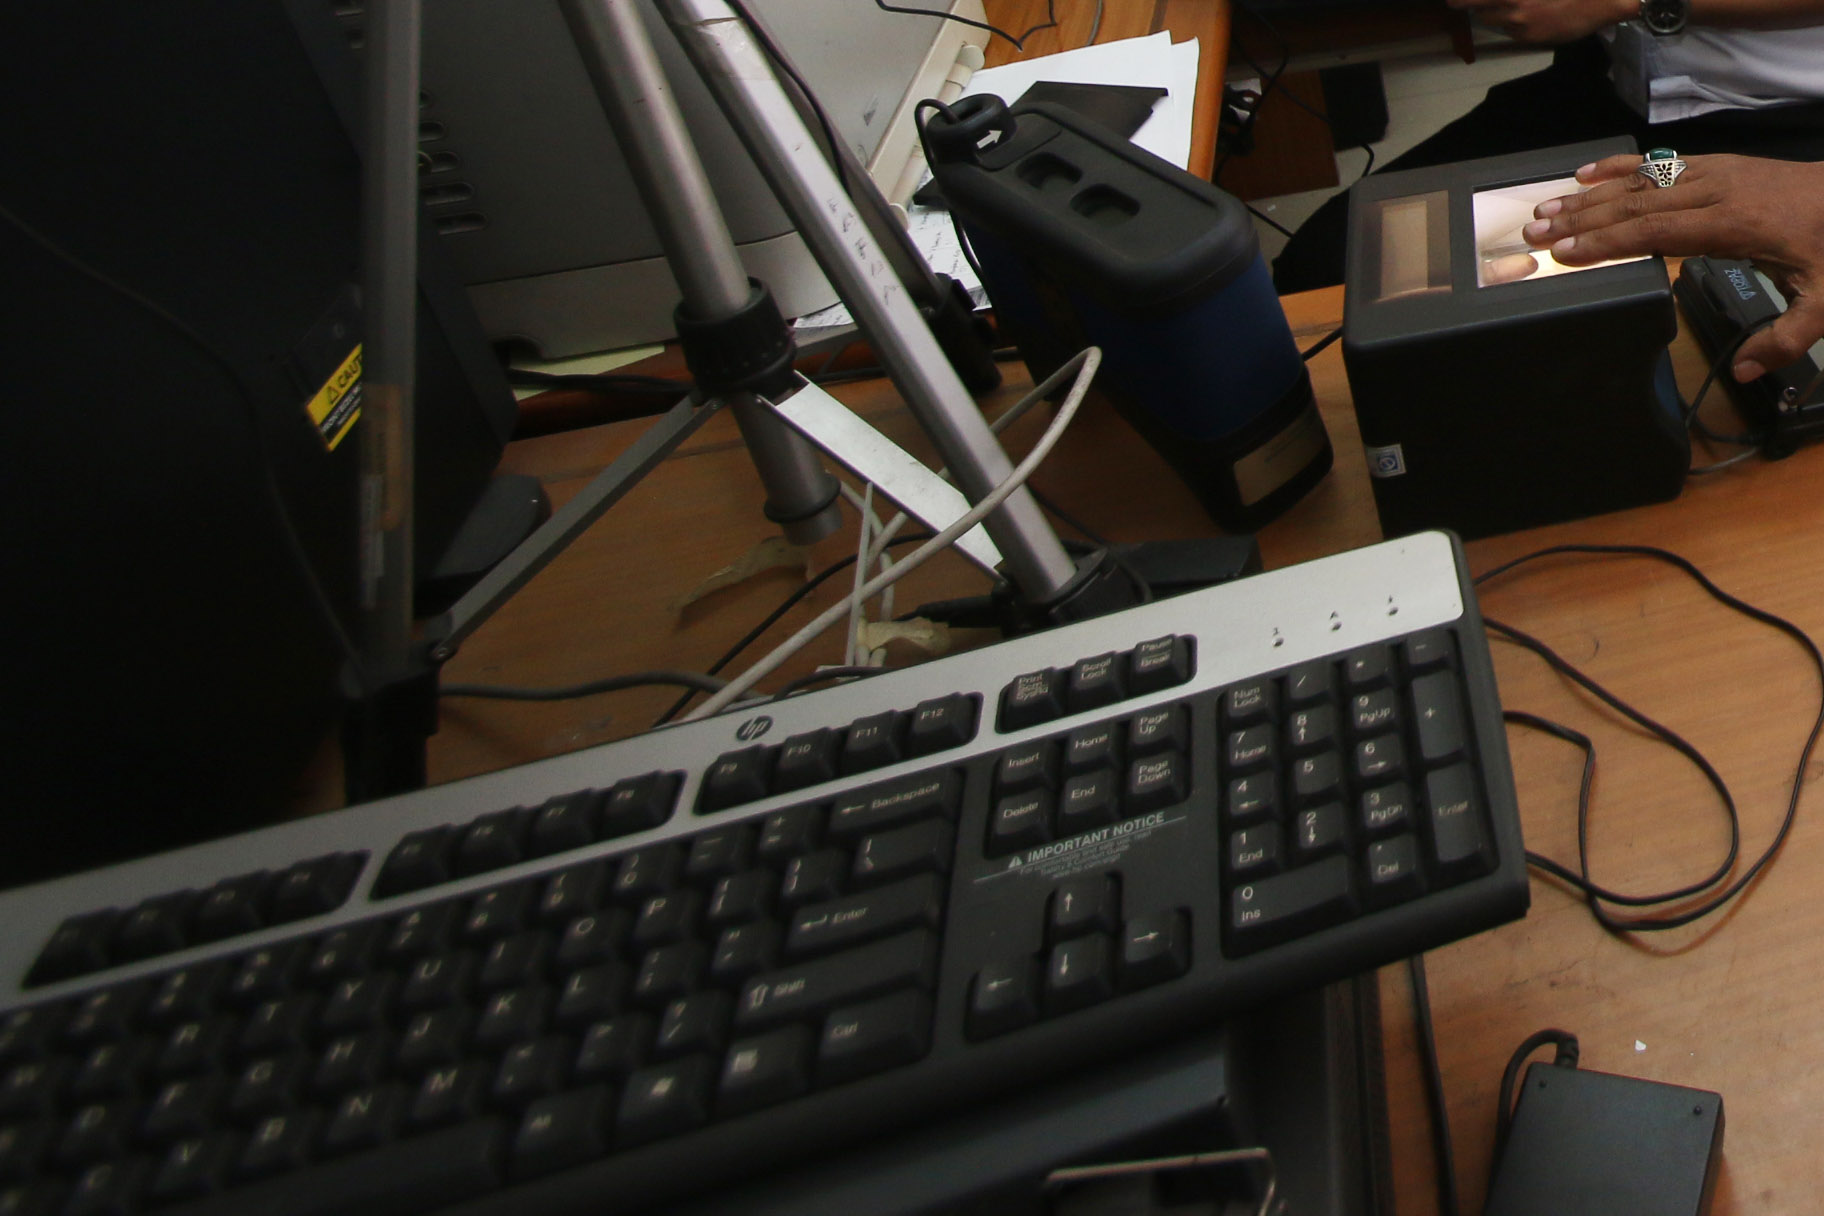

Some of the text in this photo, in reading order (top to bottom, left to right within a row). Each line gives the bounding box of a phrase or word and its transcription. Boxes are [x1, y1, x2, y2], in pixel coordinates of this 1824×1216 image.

[1082, 659, 1111, 673] Scroll
[1018, 673, 1043, 685] Print
[1081, 668, 1107, 681] Lock
[1233, 686, 1261, 700] Num
[1233, 695, 1261, 709] Lock
[1359, 695, 1369, 707] 9
[921, 708, 944, 720] F12
[1140, 712, 1169, 726] Page
[1297, 714, 1307, 726] 8
[1360, 708, 1390, 723] PgUp
[738, 716, 771, 740] hp
[856, 727, 878, 738] F11
[1139, 724, 1157, 735] Up
[1075, 734, 1108, 749] Home
[1237, 731, 1246, 743] 7
[788, 744, 811, 757] F10
[1235, 745, 1267, 760] Home
[1365, 742, 1375, 754] 6
[1008, 753, 1040, 767] Insert
[1139, 760, 1169, 774] Page
[1303, 761, 1314, 773] 5
[1138, 768, 1171, 784] Down
[1071, 786, 1096, 800] End
[1237, 780, 1248, 792] 4
[872, 783, 940, 810] Backspace
[1370, 792, 1380, 804] 3
[1003, 801, 1039, 819] Delete
[1438, 800, 1469, 818] Enter
[1306, 812, 1317, 824] 2
[1028, 811, 1165, 863] IMPORTANT NOTICE
[1239, 848, 1263, 864] End
[1377, 861, 1400, 875] Del
[1242, 886, 1254, 899] 0
[832, 906, 869, 925] Enter
[1241, 908, 1261, 922] Ins
[419, 959, 442, 980] U
[429, 1068, 459, 1094] M
[348, 1092, 373, 1116] N
